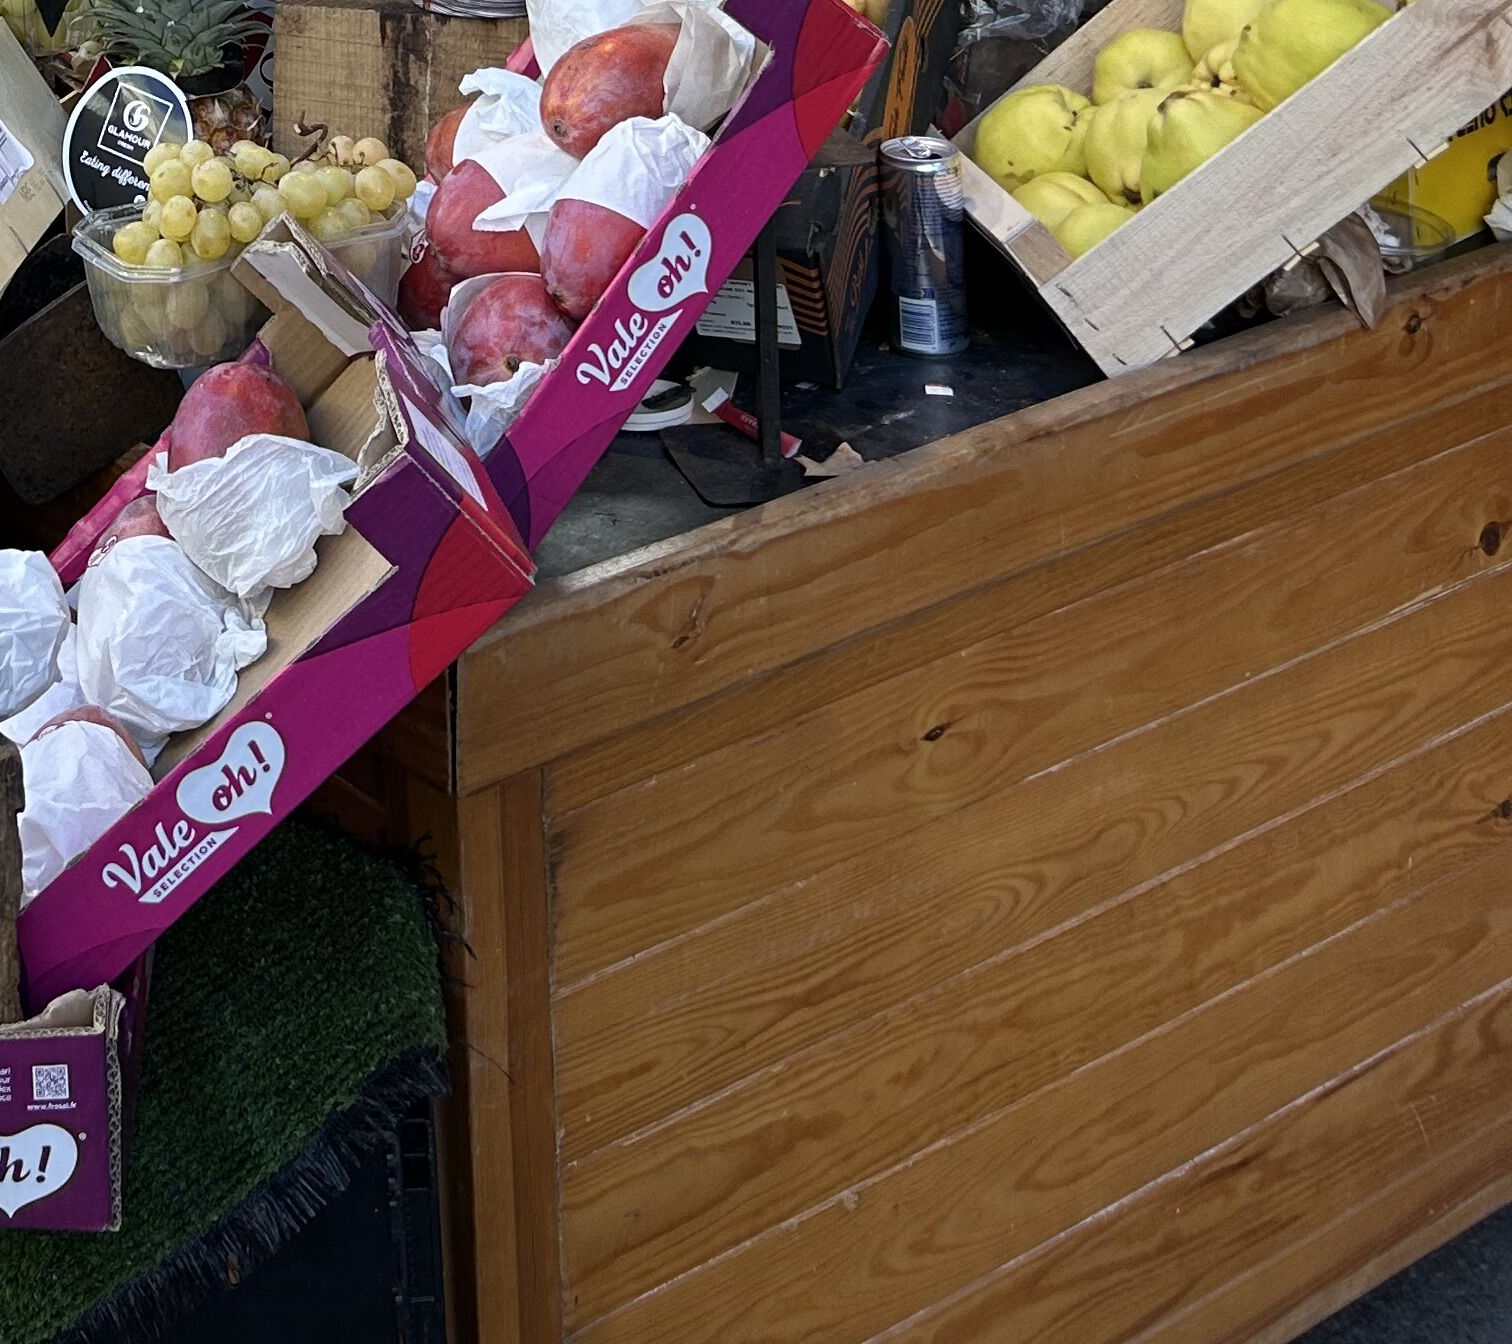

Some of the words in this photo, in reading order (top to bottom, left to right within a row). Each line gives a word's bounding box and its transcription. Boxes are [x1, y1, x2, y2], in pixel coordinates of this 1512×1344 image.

[107, 124, 151, 150] GLAMOUR
[79, 150, 110, 178] Eating
[112, 162, 151, 192] differen
[656, 230, 702, 300] oh!
[577, 311, 652, 387] Vale
[620, 323, 667, 387] SELECTION
[212, 739, 271, 813] oh!
[102, 819, 197, 895] Vale
[153, 837, 218, 898] SELECTION
